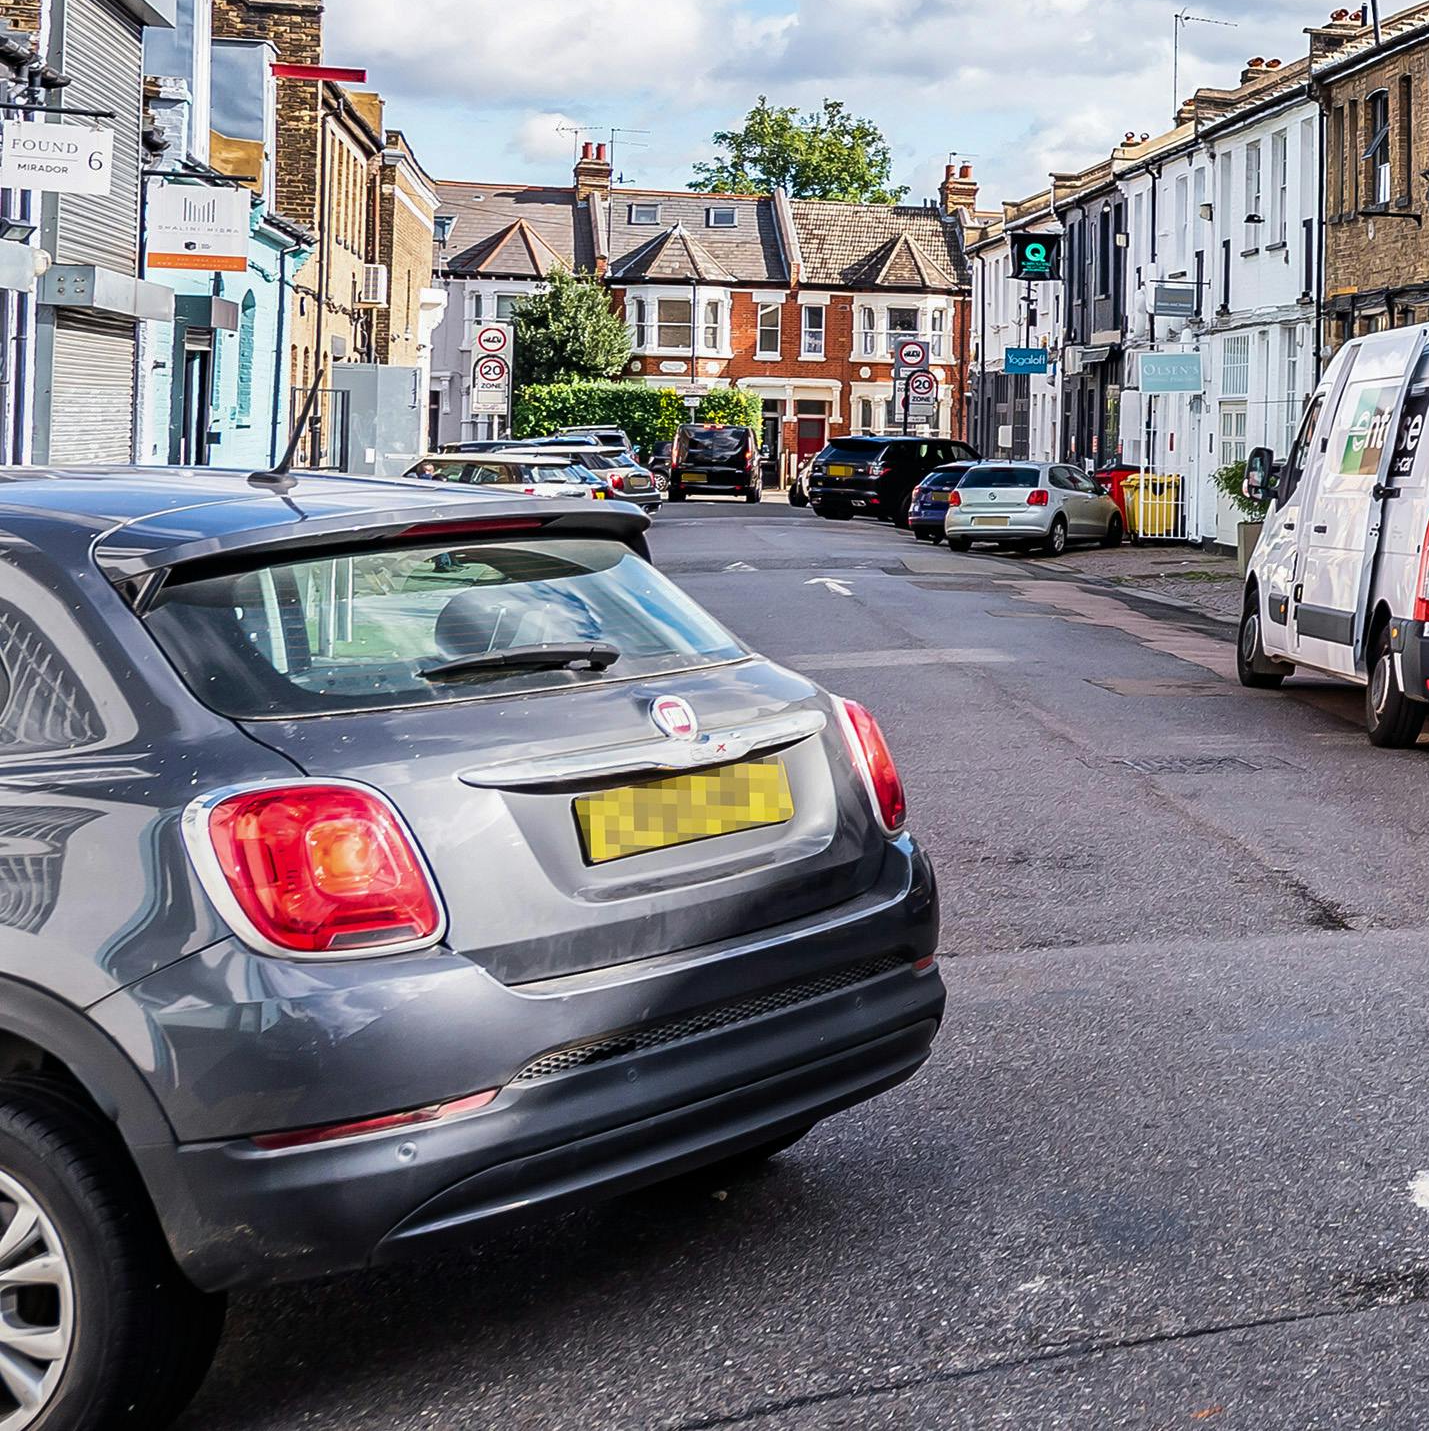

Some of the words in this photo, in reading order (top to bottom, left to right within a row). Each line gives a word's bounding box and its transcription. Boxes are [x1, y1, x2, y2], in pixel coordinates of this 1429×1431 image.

[11, 137, 79, 155] FOUND
[88, 150, 103, 171] 6
[17, 162, 68, 175] MIRADOR
[1025, 242, 1046, 262] Q
[1007, 353, 1046, 366] Yogaloft
[483, 365, 502, 376] 20
[914, 380, 931, 390] 20
